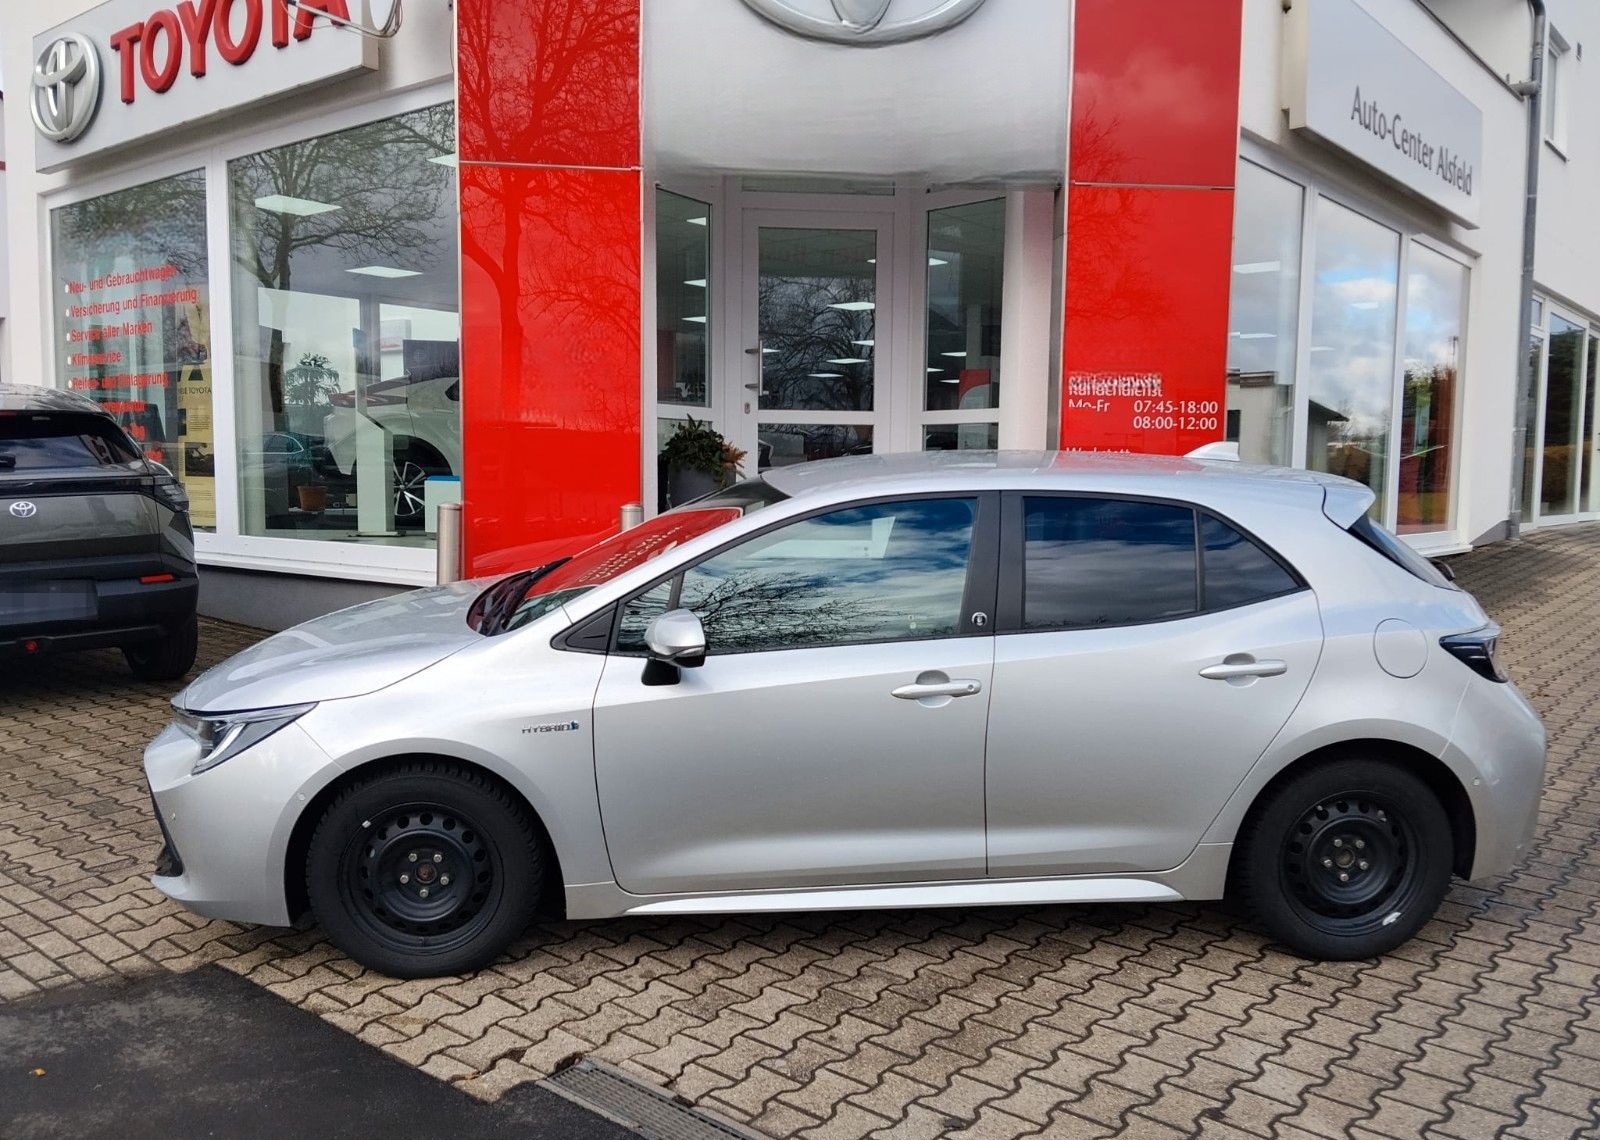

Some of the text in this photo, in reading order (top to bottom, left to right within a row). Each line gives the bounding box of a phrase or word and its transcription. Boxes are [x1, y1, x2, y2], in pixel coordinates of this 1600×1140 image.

[1351, 85, 1473, 197] Auto-Center Alsfeld
[89, 277, 104, 289] und
[71, 300, 121, 318] Versicherung
[123, 296, 138, 310] und
[104, 325, 120, 338] aller
[123, 321, 153, 336] Marken
[72, 350, 122, 366] Klimvice
[1133, 400, 1218, 414] 07:45-18:00
[1133, 416, 1218, 430] 08:00-12:00
[521, 721, 571, 735] HYBRID
